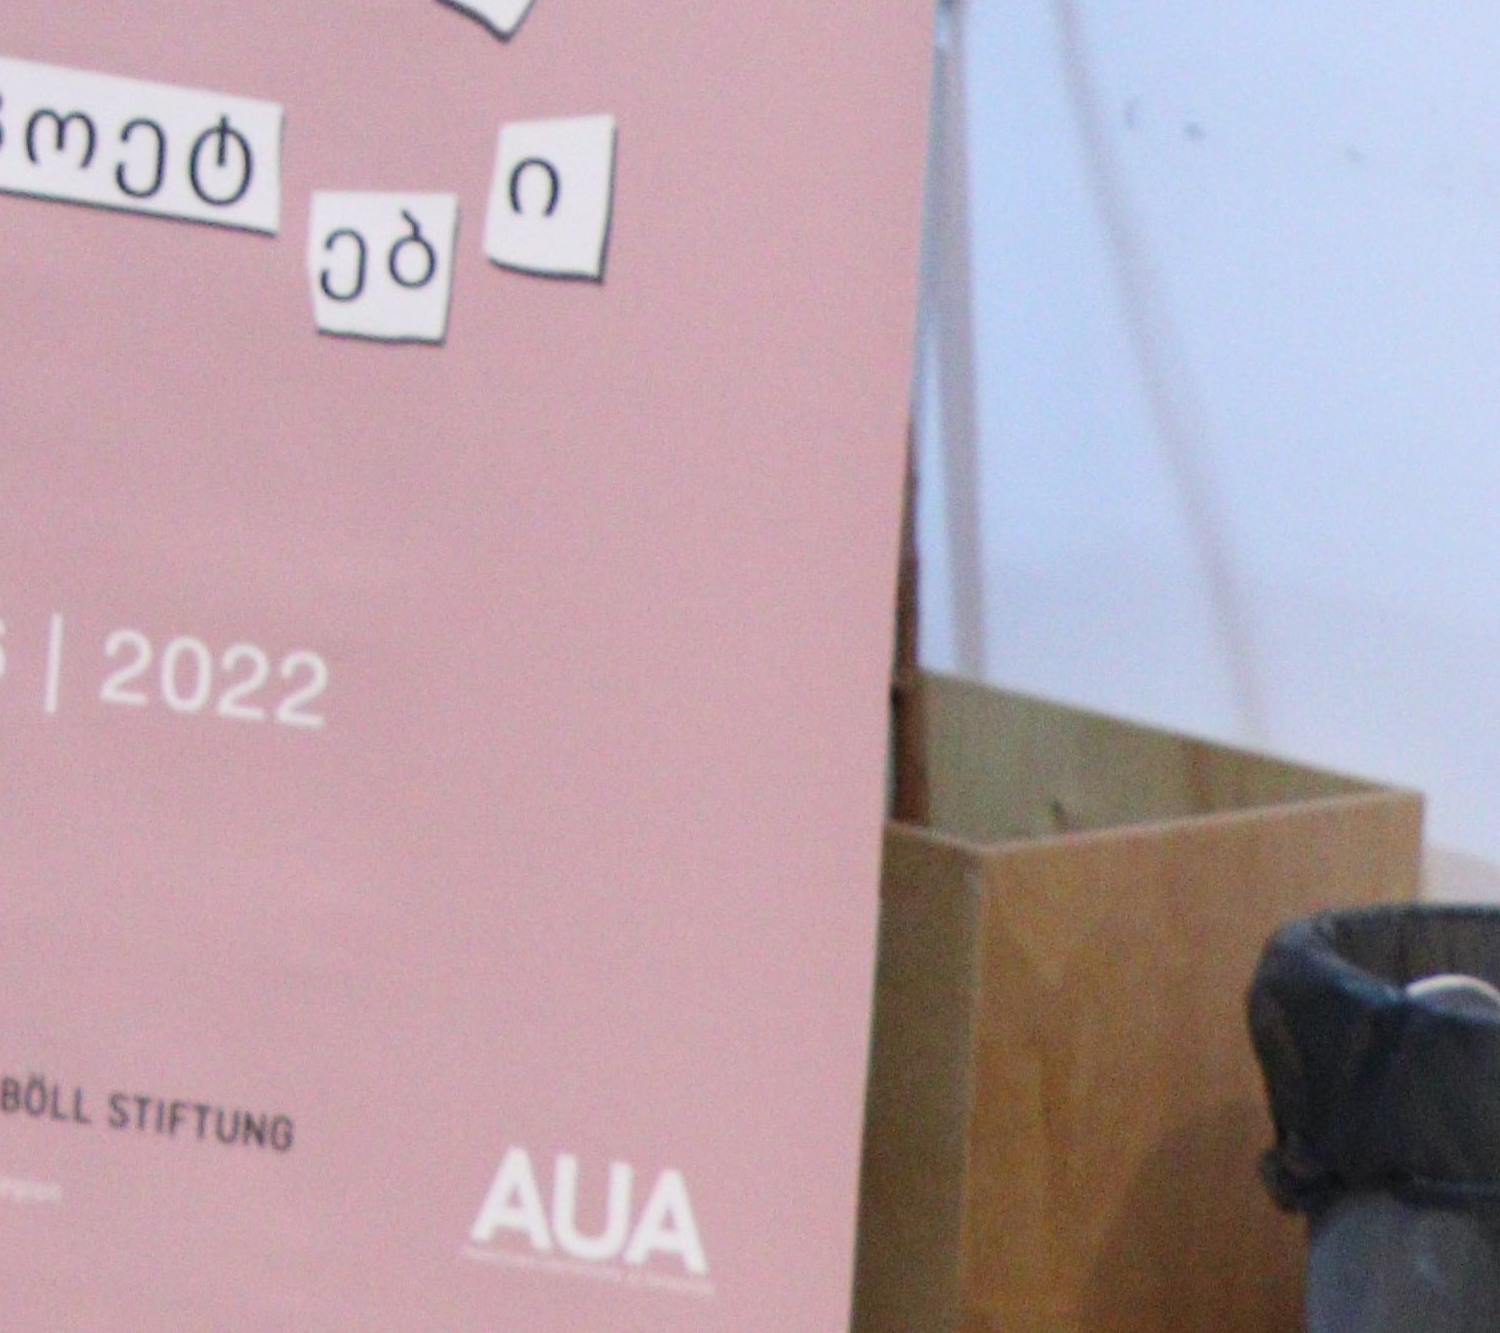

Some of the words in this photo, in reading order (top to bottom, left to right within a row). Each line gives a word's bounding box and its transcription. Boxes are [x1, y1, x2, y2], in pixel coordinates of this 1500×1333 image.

[99, 628, 330, 729] 2022
[0, 1072, 94, 1126] BÖLL
[107, 1090, 296, 1154] STIFTUNG
[469, 1144, 710, 1276] AUA
